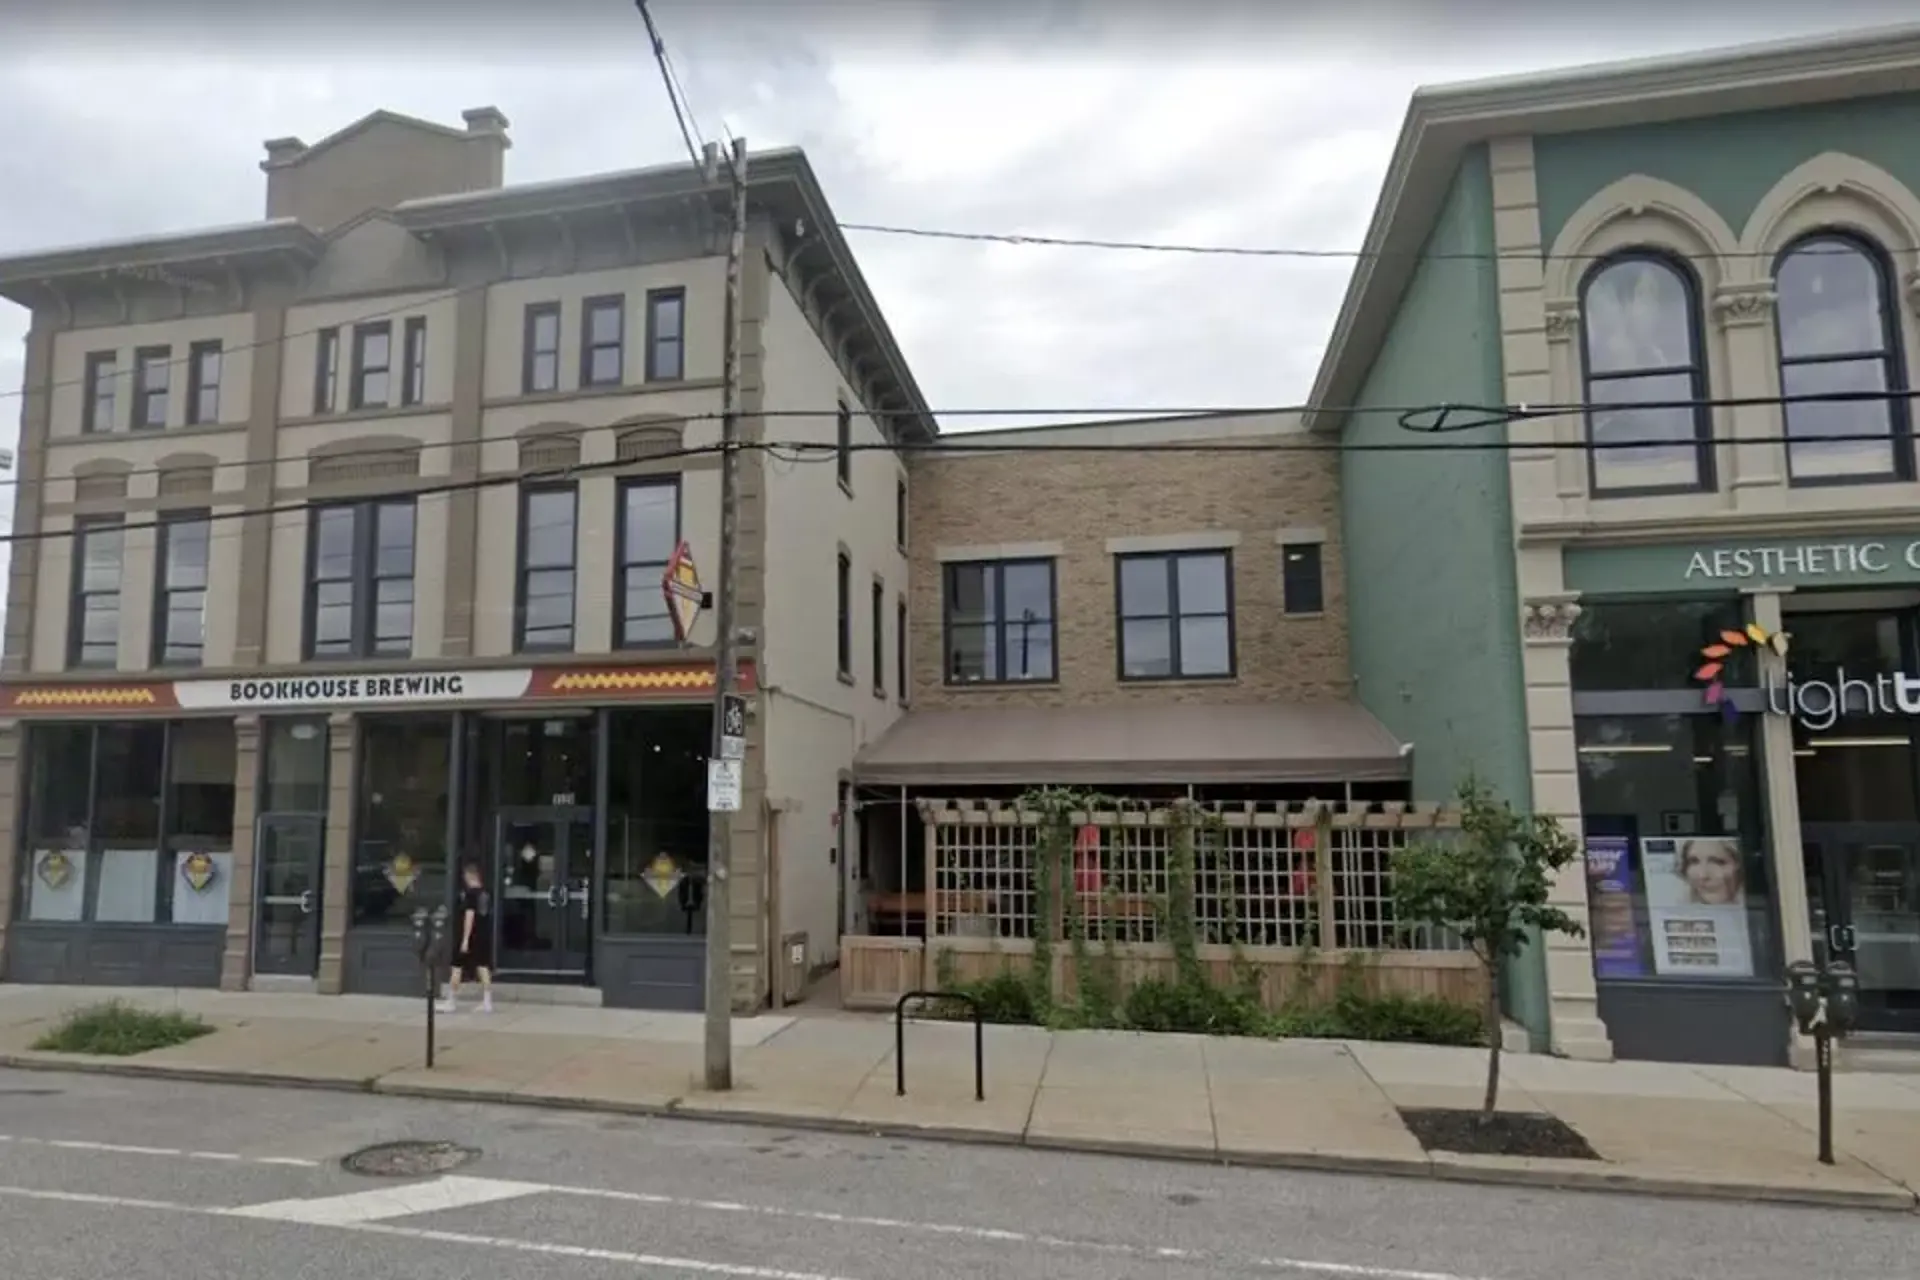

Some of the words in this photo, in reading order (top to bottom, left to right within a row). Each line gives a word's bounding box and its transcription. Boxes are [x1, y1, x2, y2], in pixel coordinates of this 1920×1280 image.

[1684, 542, 1890, 578] AESTHETIC
[230, 679, 360, 700] BOOKHOUSE
[365, 676, 463, 696] BREWING
